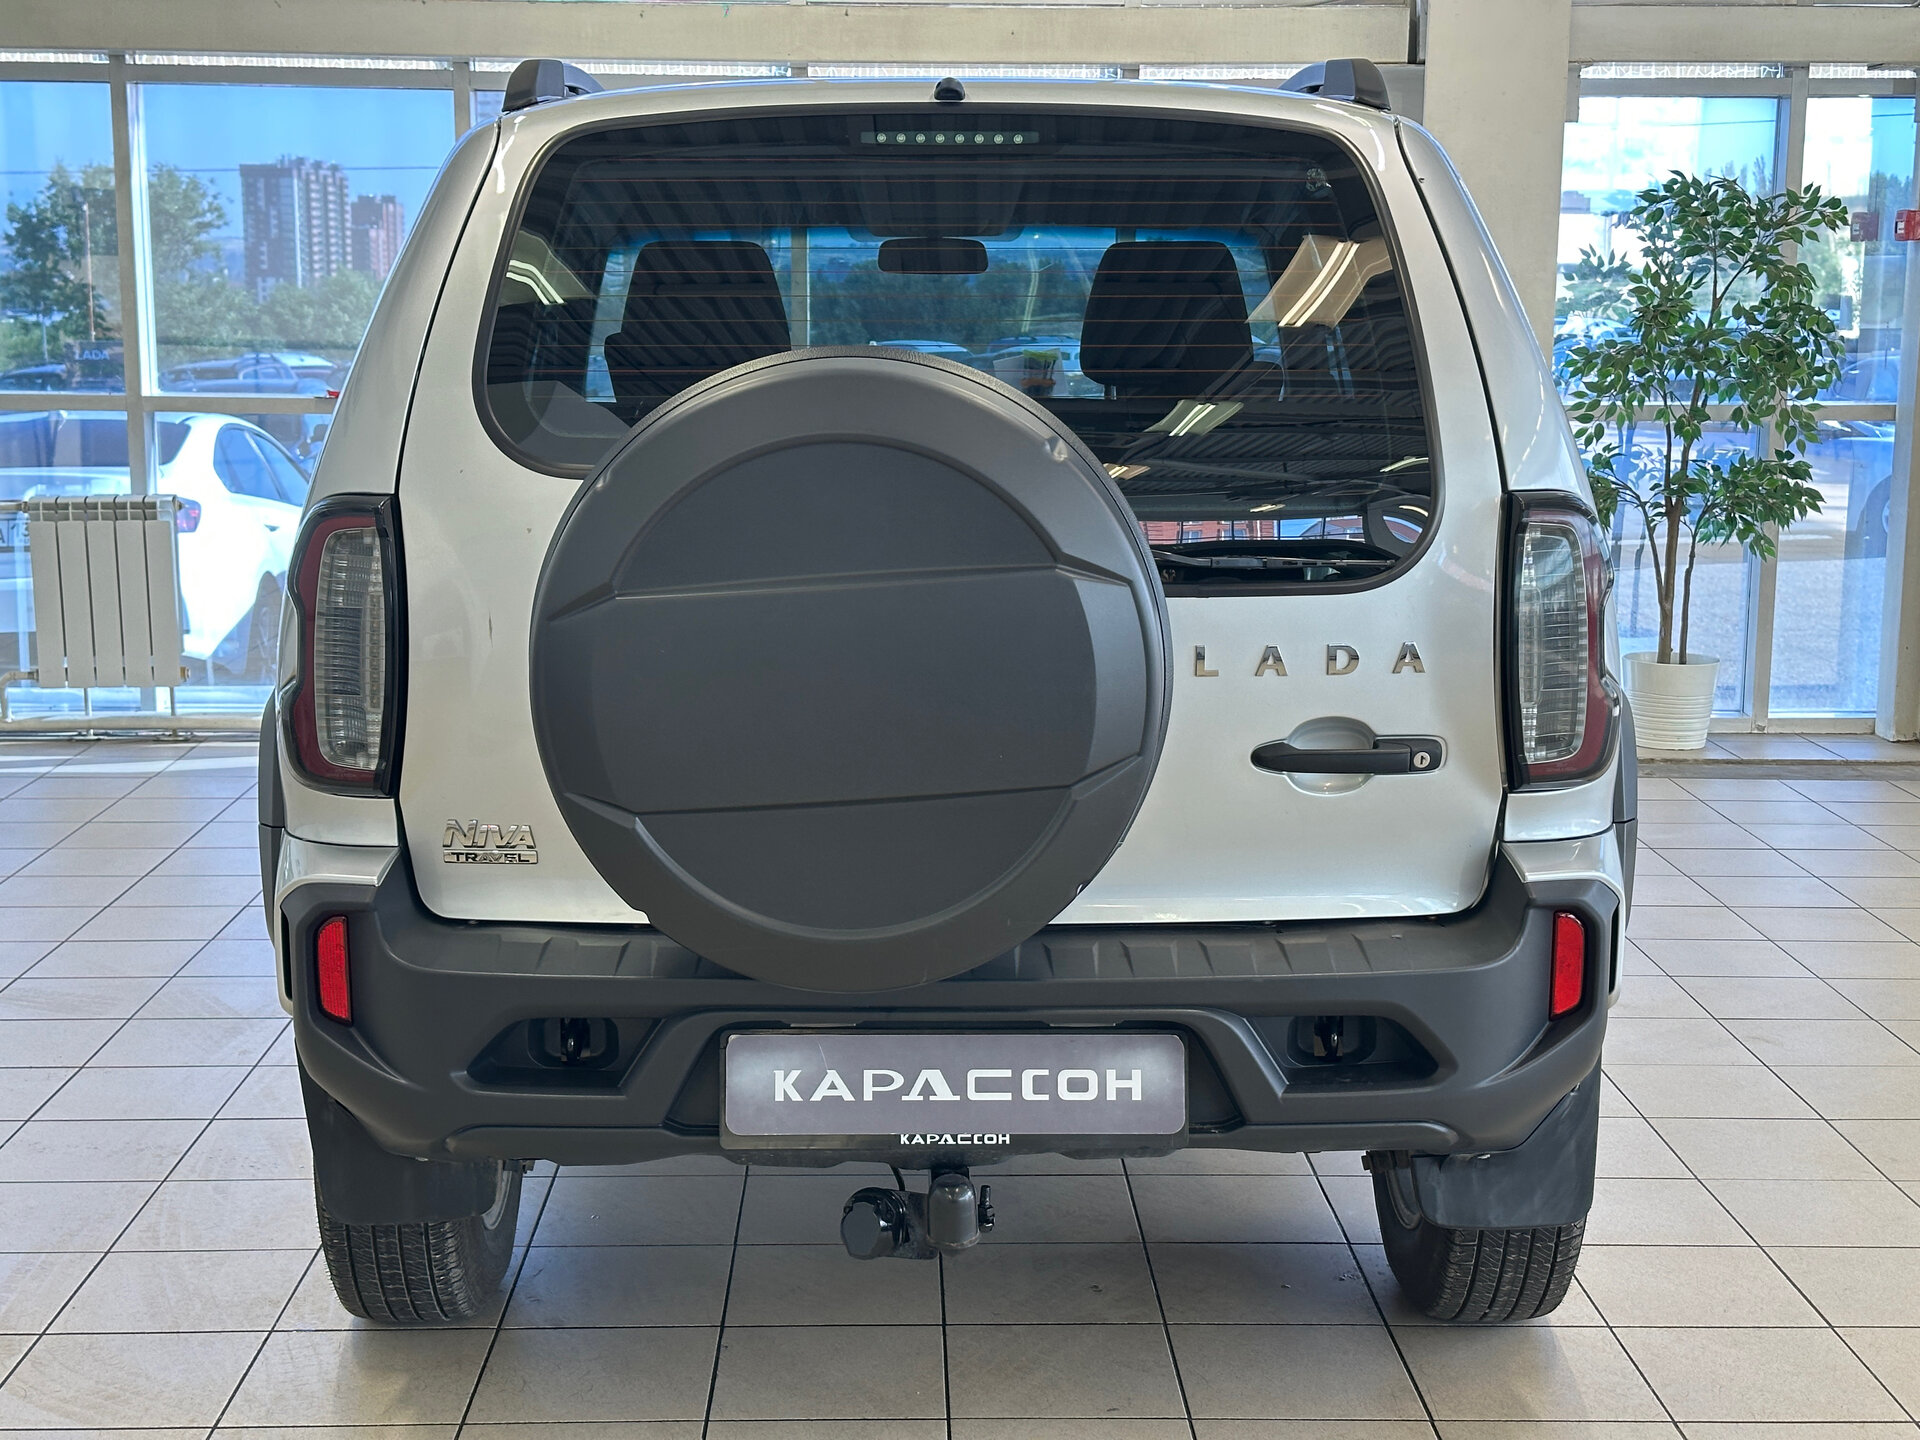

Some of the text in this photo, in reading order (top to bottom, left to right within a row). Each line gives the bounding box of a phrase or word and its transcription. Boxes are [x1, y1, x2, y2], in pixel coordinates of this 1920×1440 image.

[75, 349, 110, 360] LADA
[1194, 641, 1425, 677] LADA
[442, 819, 536, 849] NIVA
[450, 852, 530, 862] TRAVEL
[773, 1069, 1142, 1101] КАРАССОН
[900, 1133, 1010, 1145] КАРАССОН
